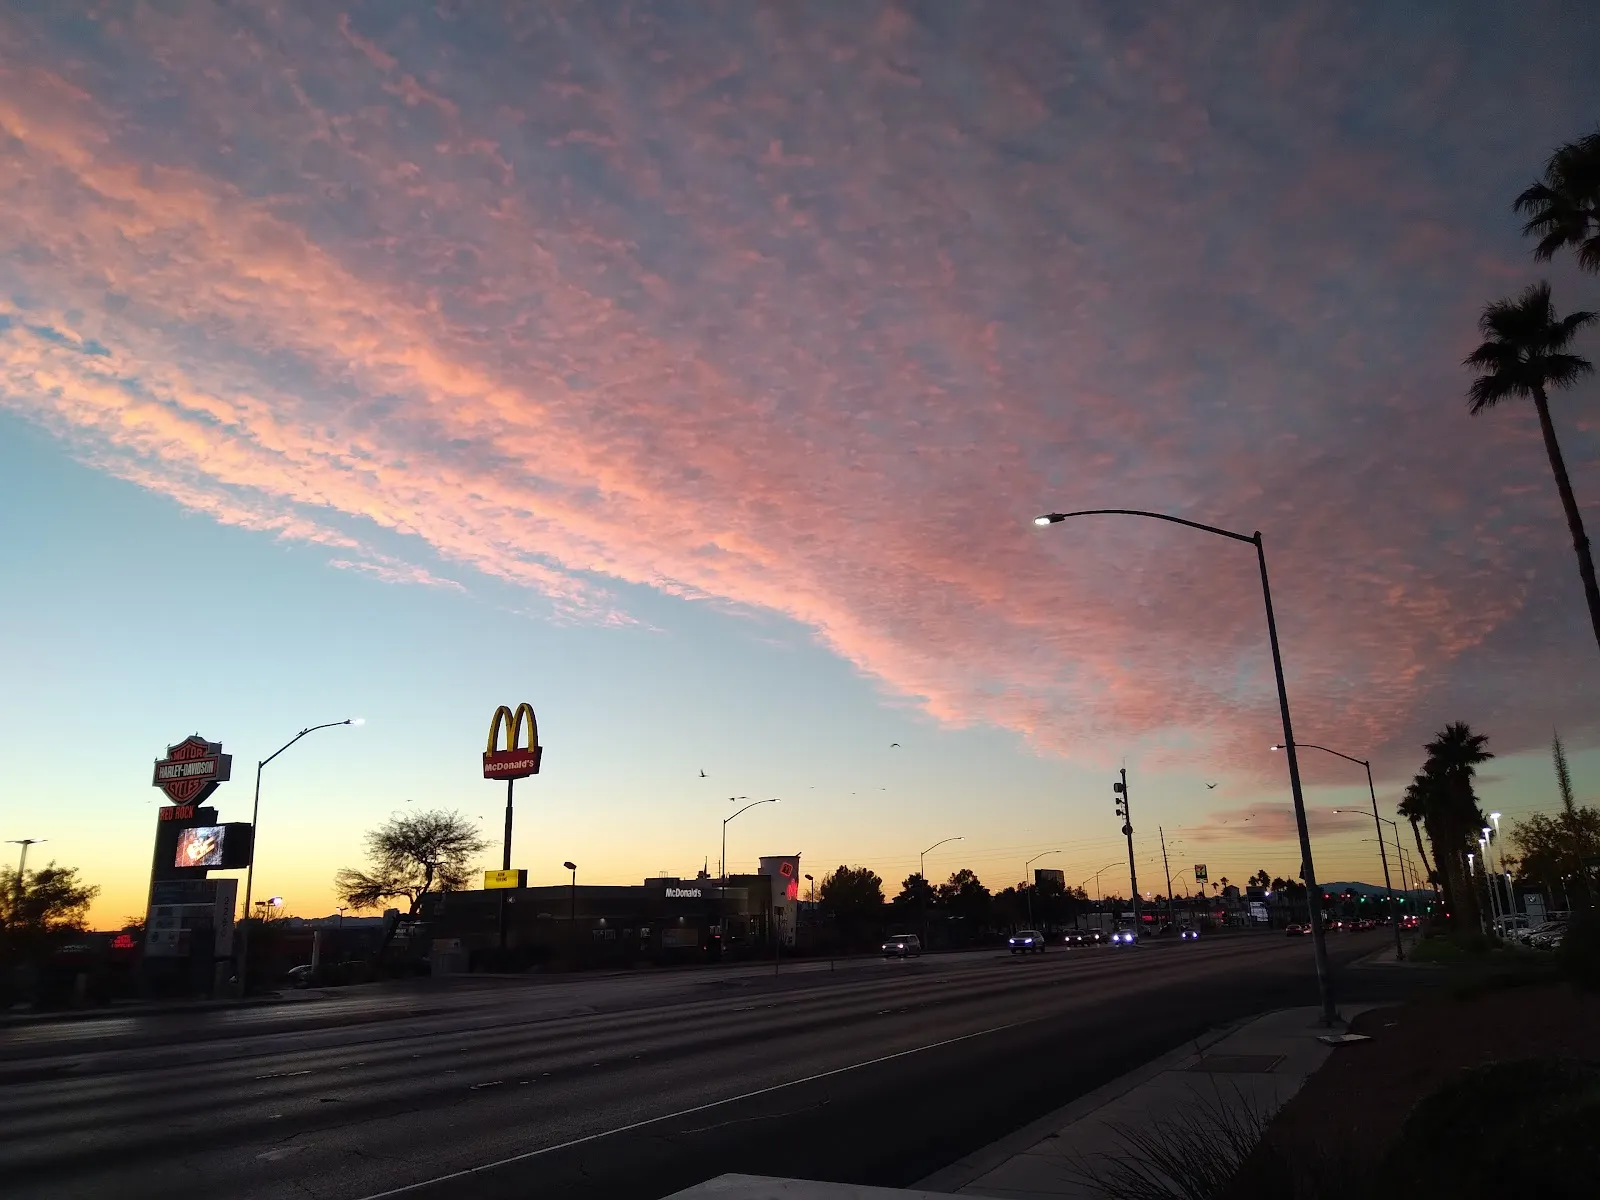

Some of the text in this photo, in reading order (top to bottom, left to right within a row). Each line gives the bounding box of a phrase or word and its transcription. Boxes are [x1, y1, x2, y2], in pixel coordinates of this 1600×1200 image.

[173, 745, 204, 760] MOTOR
[159, 761, 214, 778] HARLEY-DAVIDSON
[485, 759, 534, 772] McDonald's
[170, 779, 199, 797] CYCLES
[160, 806, 193, 820] RED ROCK
[665, 888, 702, 897] McDonald's
